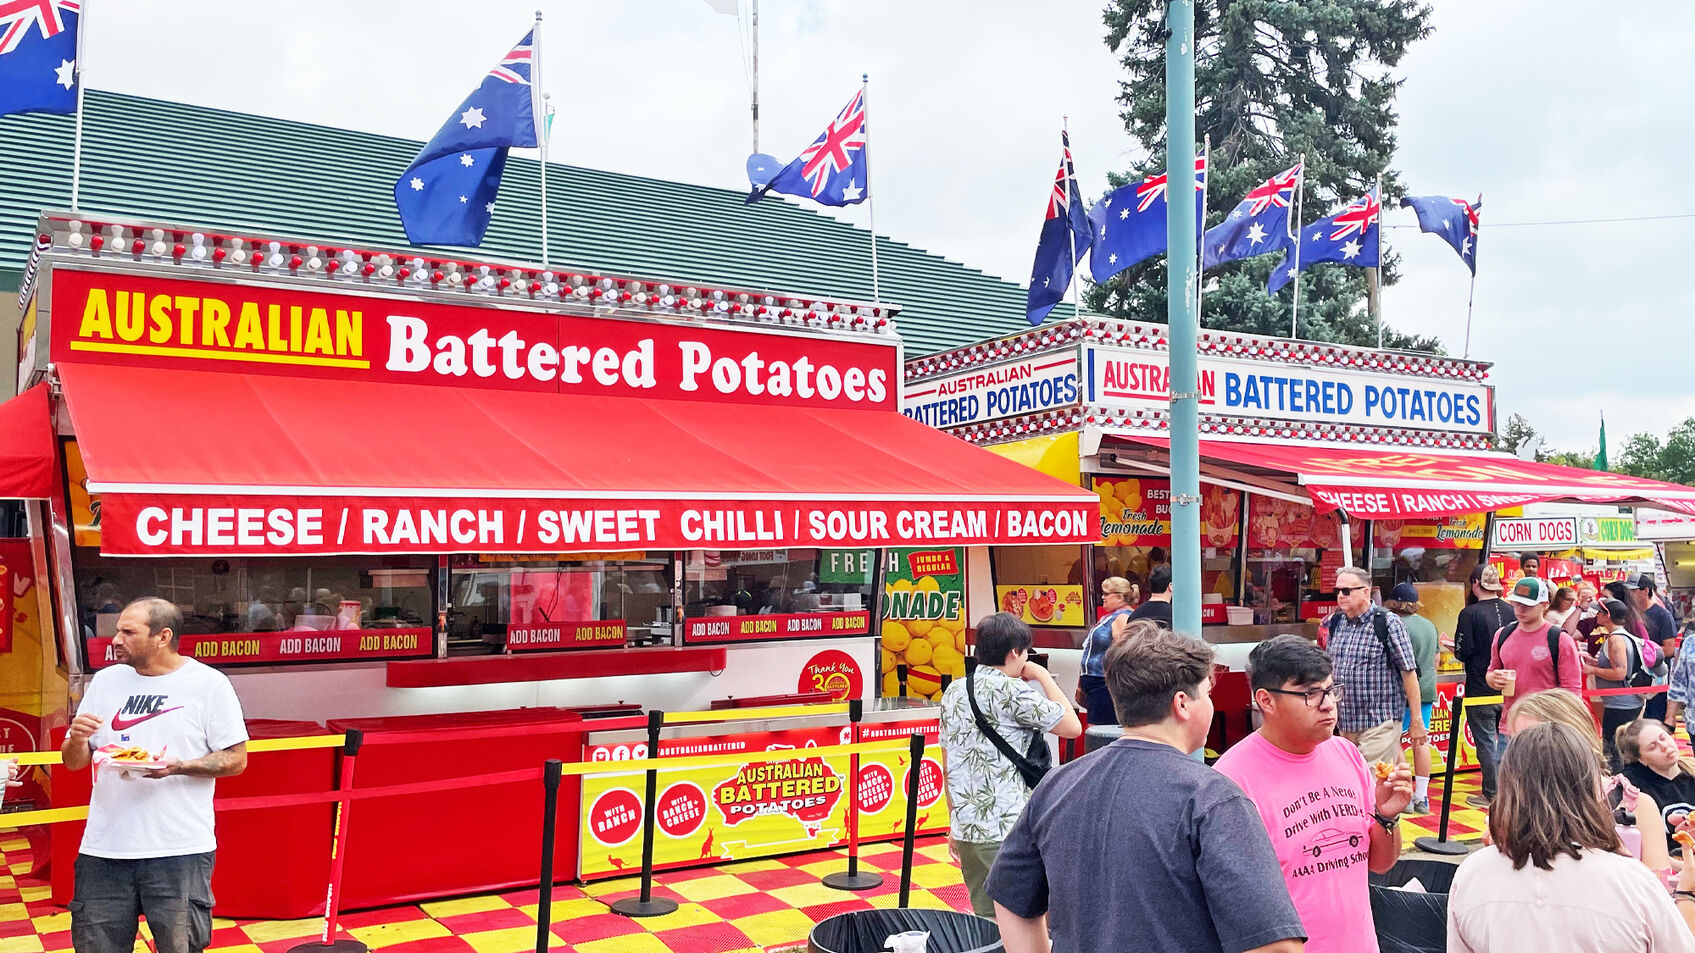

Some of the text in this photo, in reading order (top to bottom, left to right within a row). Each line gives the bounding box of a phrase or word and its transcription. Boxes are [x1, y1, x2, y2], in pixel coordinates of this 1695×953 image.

[78, 288, 888, 403] AUSTRALIAN Battered Potatoes
[938, 363, 1032, 397] AUSTRALIAN
[987, 373, 1078, 417] POTATOES
[1104, 360, 1481, 426] AUSTRAN BATTERED POTATOES
[1317, 490, 1391, 513] CHEESE
[1401, 494, 1471, 512] RANCH
[1122, 508, 1147, 521] Fresh
[136, 506, 324, 546] CHEESE
[362, 508, 504, 545] RANCH
[537, 509, 660, 544] SWEET
[681, 509, 784, 541] CHILLI
[809, 509, 888, 540] SOUR
[896, 509, 987, 539] CREAM
[1006, 509, 1088, 537] BACON
[1099, 516, 1164, 538] Lemonade
[1436, 523, 1484, 542] Lemonade
[1499, 521, 1573, 542] CORN DOGS
[916, 555, 942, 564] JUMBO
[917, 563, 952, 573] REGULAR
[692, 622, 729, 636] ADD BACON
[741, 620, 777, 634] ADD BACON
[787, 618, 822, 632] ADD BACON
[832, 616, 865, 629] ADD BACON
[359, 634, 417, 651] ADD BACON
[510, 628, 560, 644] ADD BACON
[575, 625, 623, 641] ADD BACON
[195, 640, 260, 657] ADD BACON
[279, 637, 341, 654] ADD BACON
[807, 662, 855, 675] Thank You
[121, 694, 168, 714] NIKE
[736, 763, 823, 785] AUSTRALIAN
[720, 776, 841, 805] BATTERED
[862, 790, 889, 808] BACON
[670, 795, 688, 807] WITH
[730, 796, 826, 815] POTATOES
[1283, 796, 1308, 818] Don't
[1308, 790, 1321, 804] Be
[1323, 786, 1331, 799] A
[604, 804, 626, 818] WITH
[666, 808, 700, 828] CHEESE
[597, 809, 637, 833] RANCH
[1284, 817, 1309, 838] Drive
[1310, 807, 1332, 825] With
[1317, 854, 1350, 873] Driving
